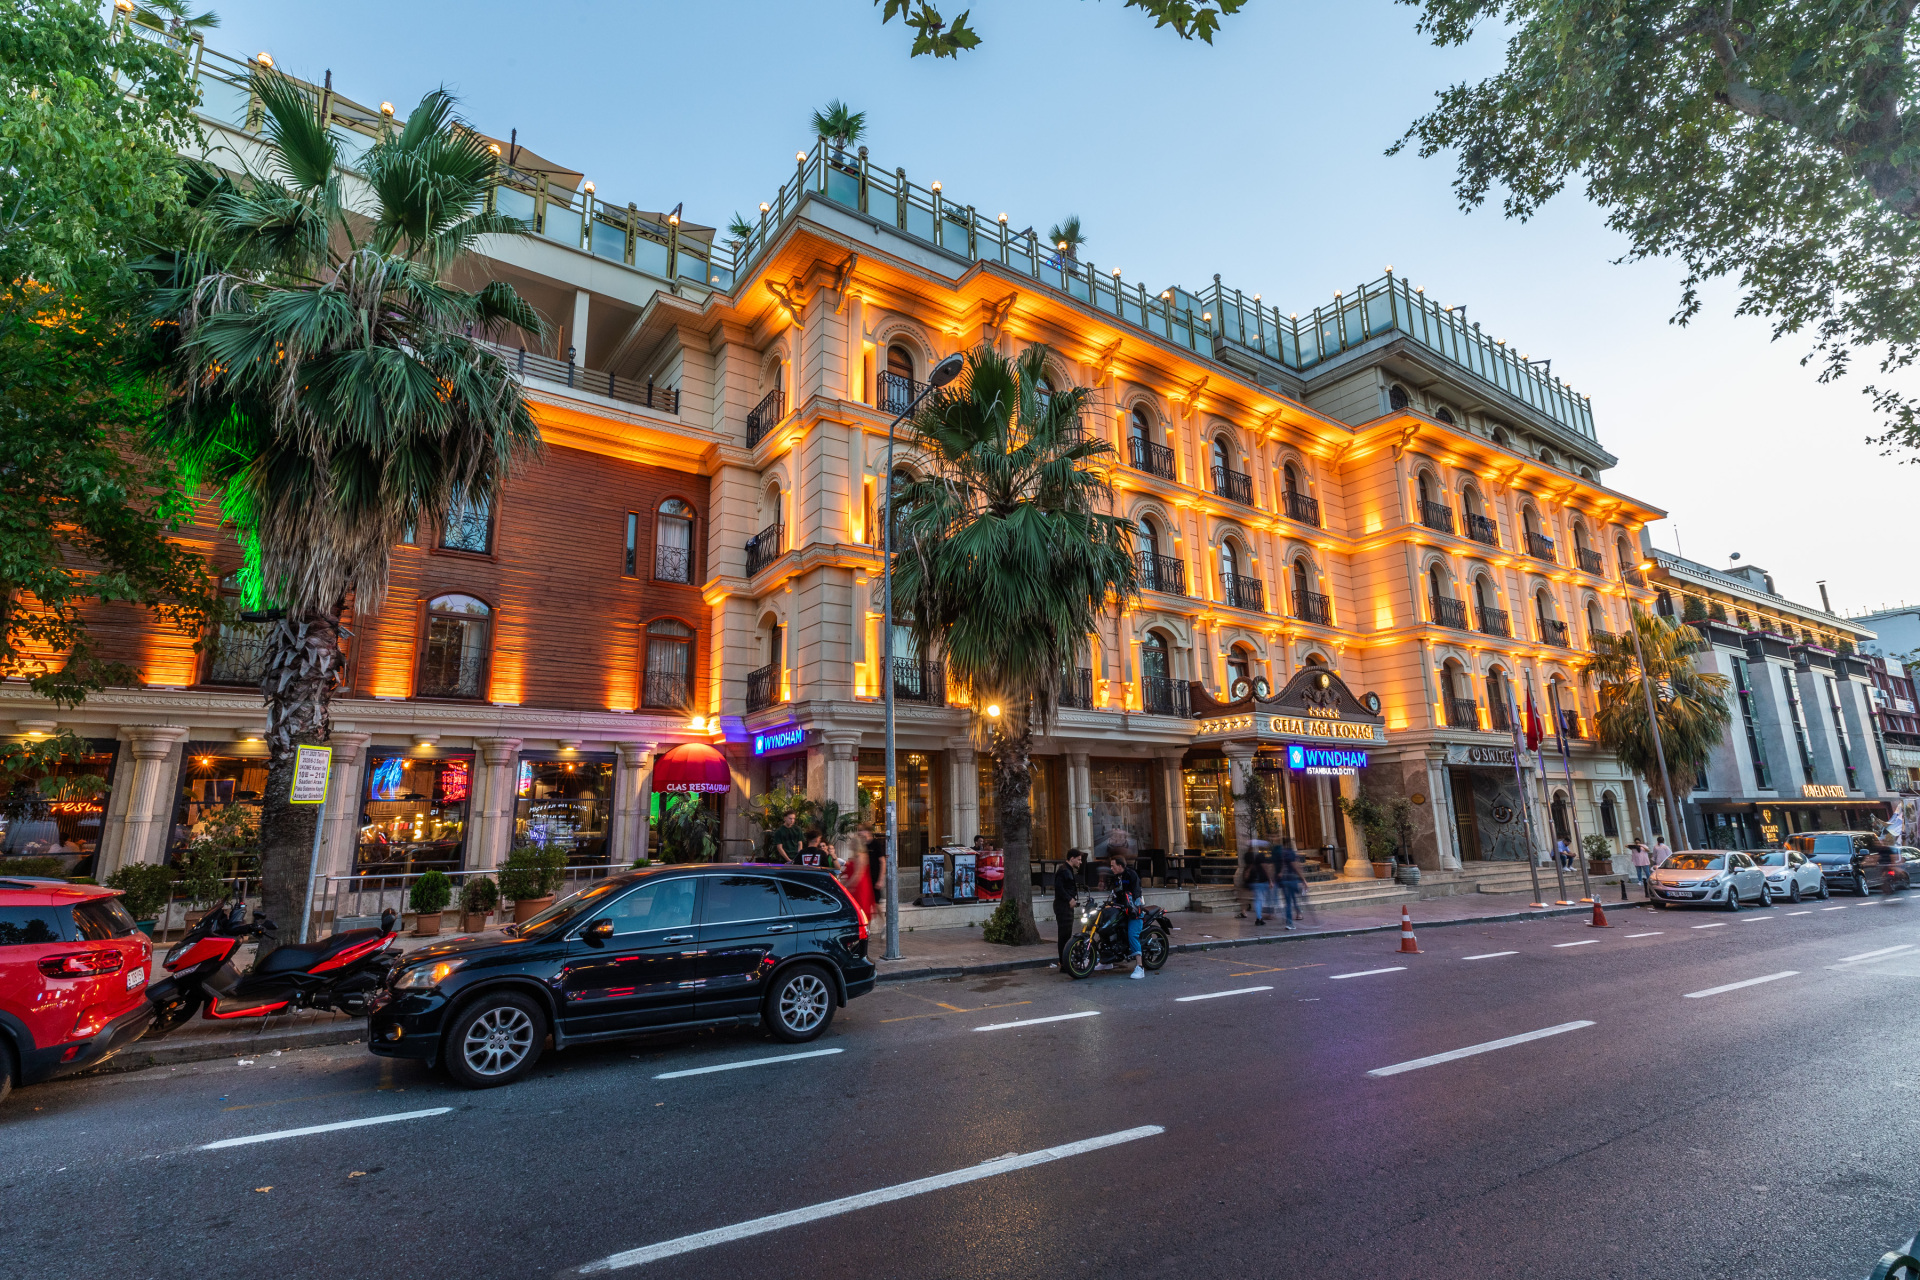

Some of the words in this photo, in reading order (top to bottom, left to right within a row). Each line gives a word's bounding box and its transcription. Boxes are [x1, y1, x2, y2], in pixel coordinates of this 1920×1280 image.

[764, 728, 802, 750] WYNDHAM
[1311, 721, 1332, 737] AĞA
[1335, 723, 1375, 740] KONAĞI
[1305, 750, 1367, 768] WYNDHAM
[1332, 767, 1343, 775] OLD
[1343, 768, 1355, 776] CITY
[666, 783, 687, 791] CLAS
[689, 783, 730, 792] RESTAURANT
